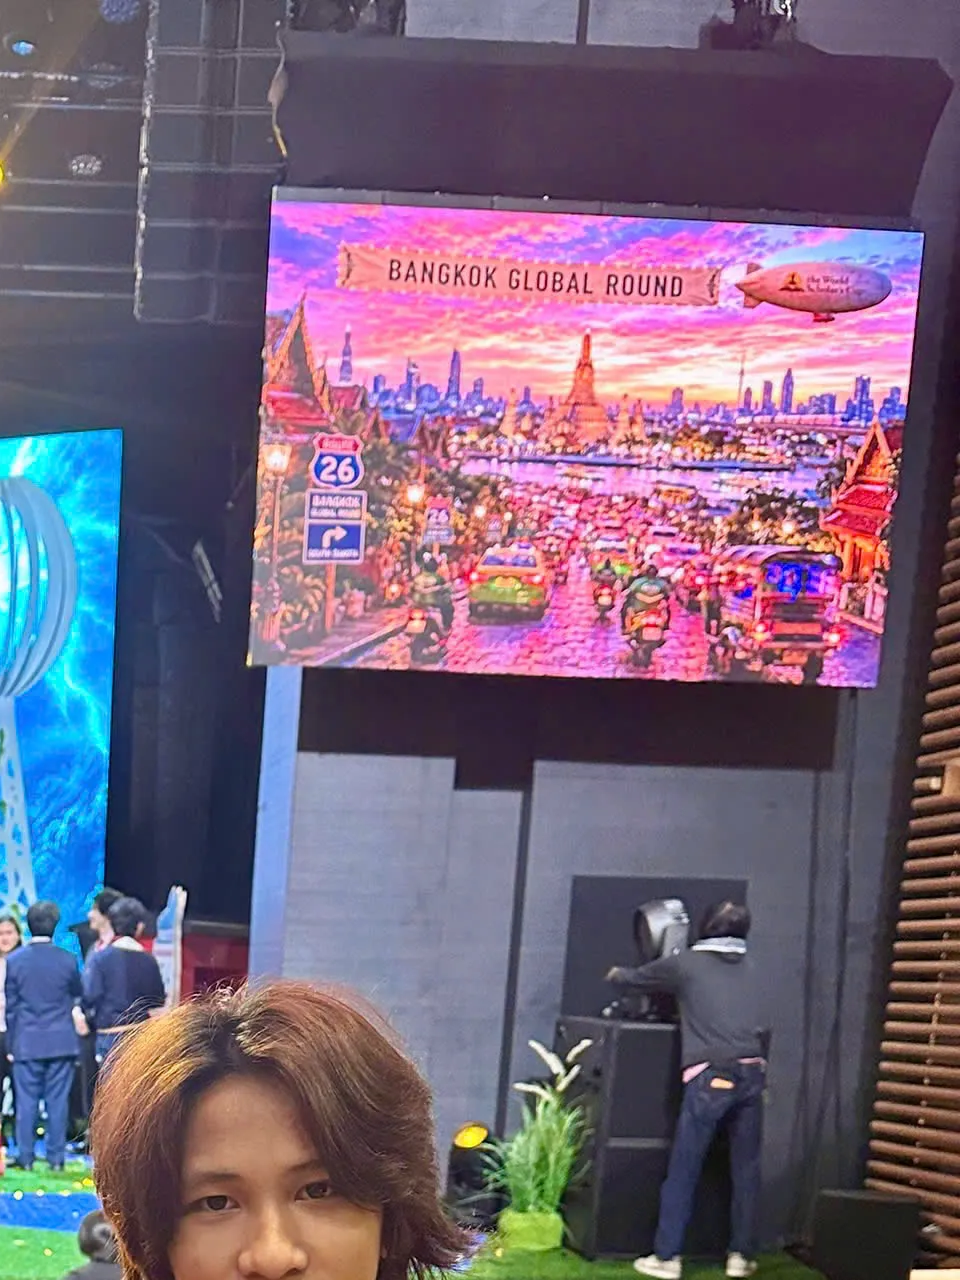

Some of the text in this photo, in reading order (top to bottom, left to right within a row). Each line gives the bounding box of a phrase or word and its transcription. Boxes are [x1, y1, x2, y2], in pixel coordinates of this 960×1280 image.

[389, 259, 683, 297] BANGKOK GLOBAL ROUND
[320, 455, 355, 482] 26
